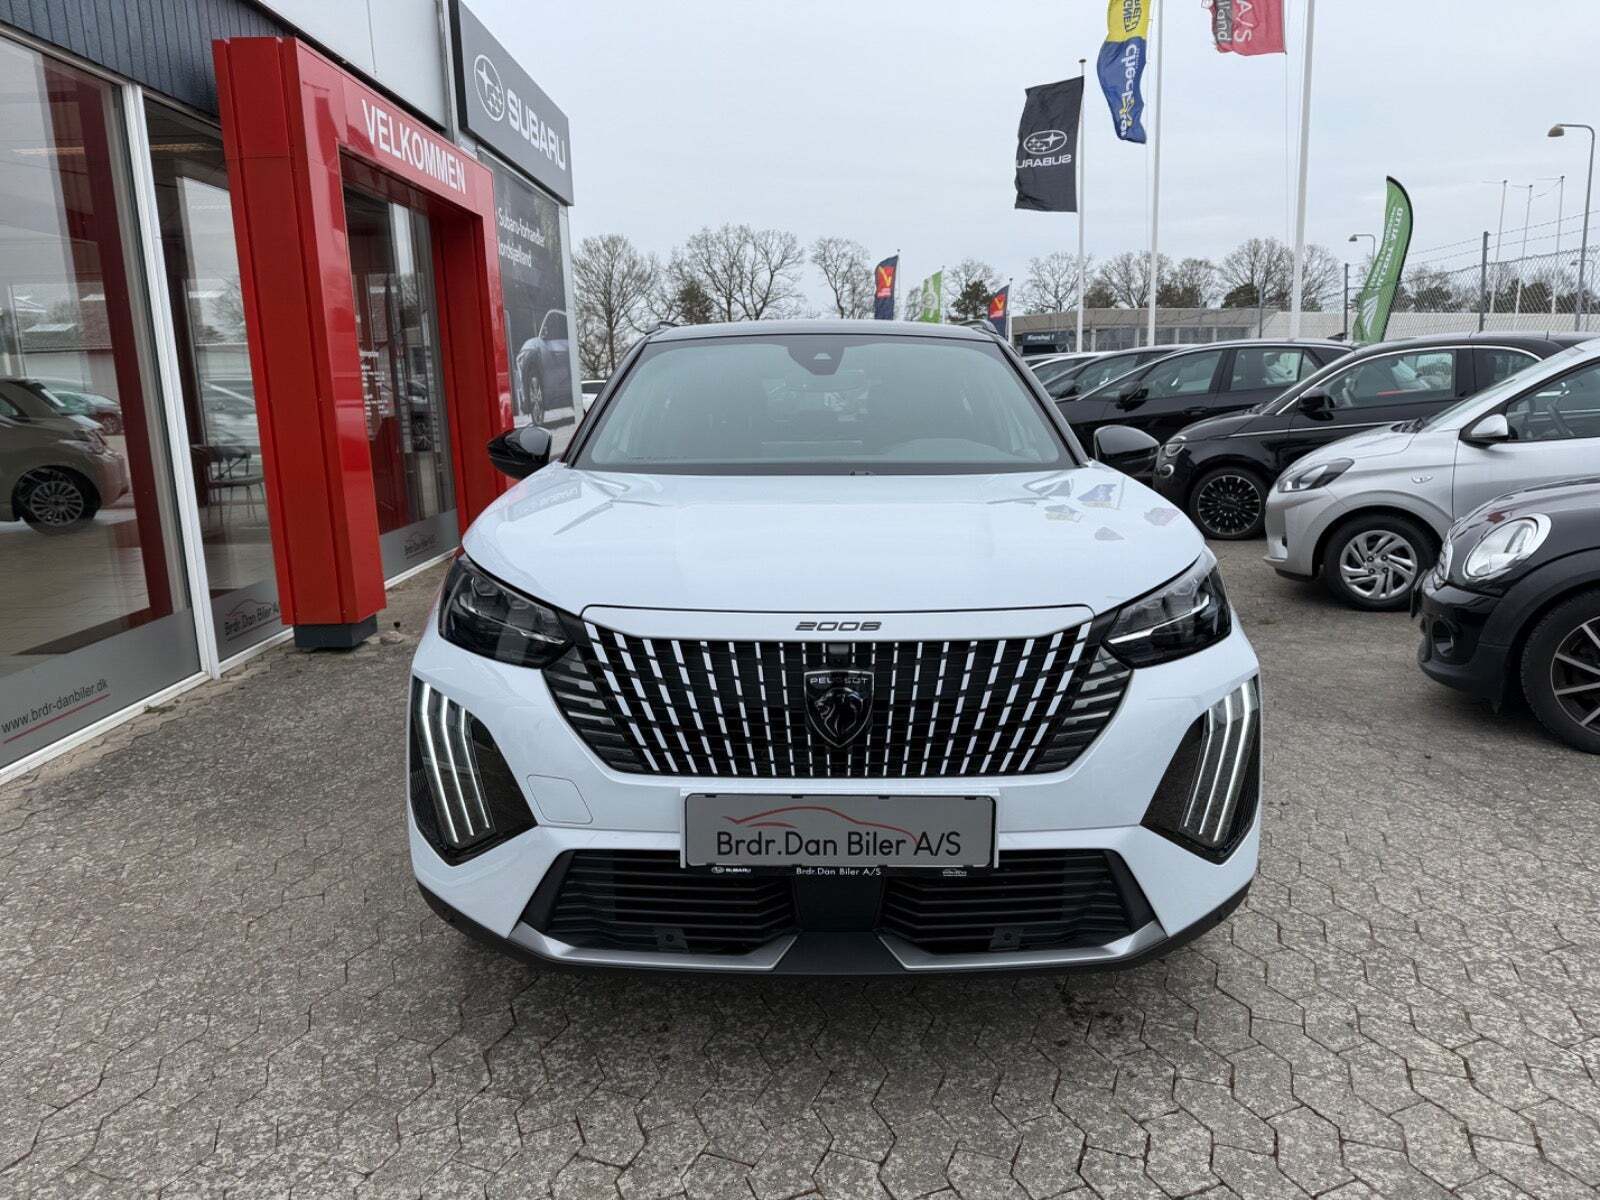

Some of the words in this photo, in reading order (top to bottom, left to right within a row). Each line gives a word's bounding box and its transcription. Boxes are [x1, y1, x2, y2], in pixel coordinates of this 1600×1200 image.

[362, 99, 466, 194] VELKOMMEN
[507, 89, 566, 171] SUBARU
[795, 621, 882, 631] 2008
[1, 679, 108, 733] www.brdr-danbiler.dk
[847, 831, 907, 856] Biler
[913, 831, 961, 856] A/S
[839, 867, 860, 876] Biler
[862, 867, 882, 876] A/S
